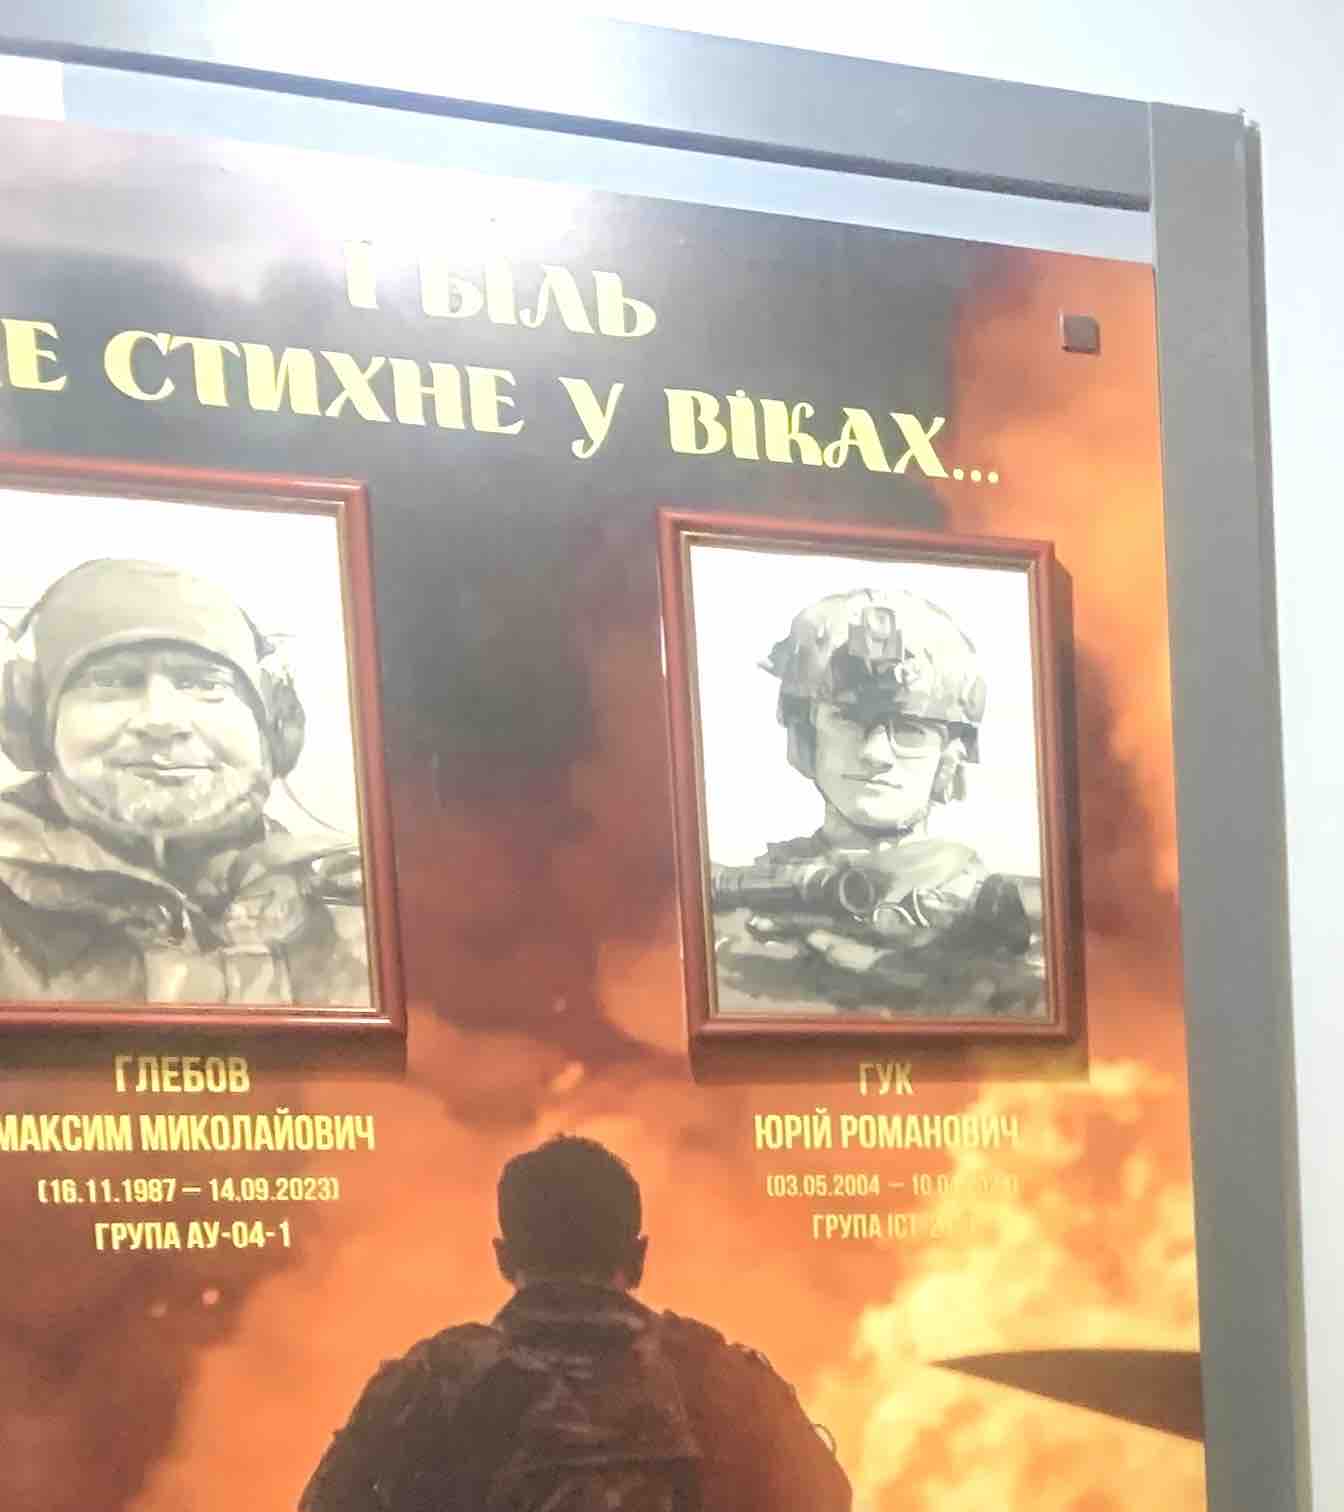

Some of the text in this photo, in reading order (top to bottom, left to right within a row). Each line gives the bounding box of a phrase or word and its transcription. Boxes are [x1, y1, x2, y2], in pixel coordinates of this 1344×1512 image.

[0, 317, 999, 484] Е СТИХНЕ У ВІКАХ...
[114, 1055, 251, 1094] ГЛЕБОВ
[858, 1061, 914, 1096] ГУК
[0, 1107, 375, 1152] МАКСИМ МИКОЛАЙОВИЧ
[754, 1107, 1020, 1150] ЮРІЙ РОМАНОВИЧ
[36, 1178, 177, 1204] (16.11.1987
[208, 1177, 340, 1202] 14.09.2023)
[766, 1173, 881, 1197] (03.05.2004
[94, 1220, 291, 1251] ГРУПА АУ-04-1
[811, 1213, 882, 1241] ГРУПА
